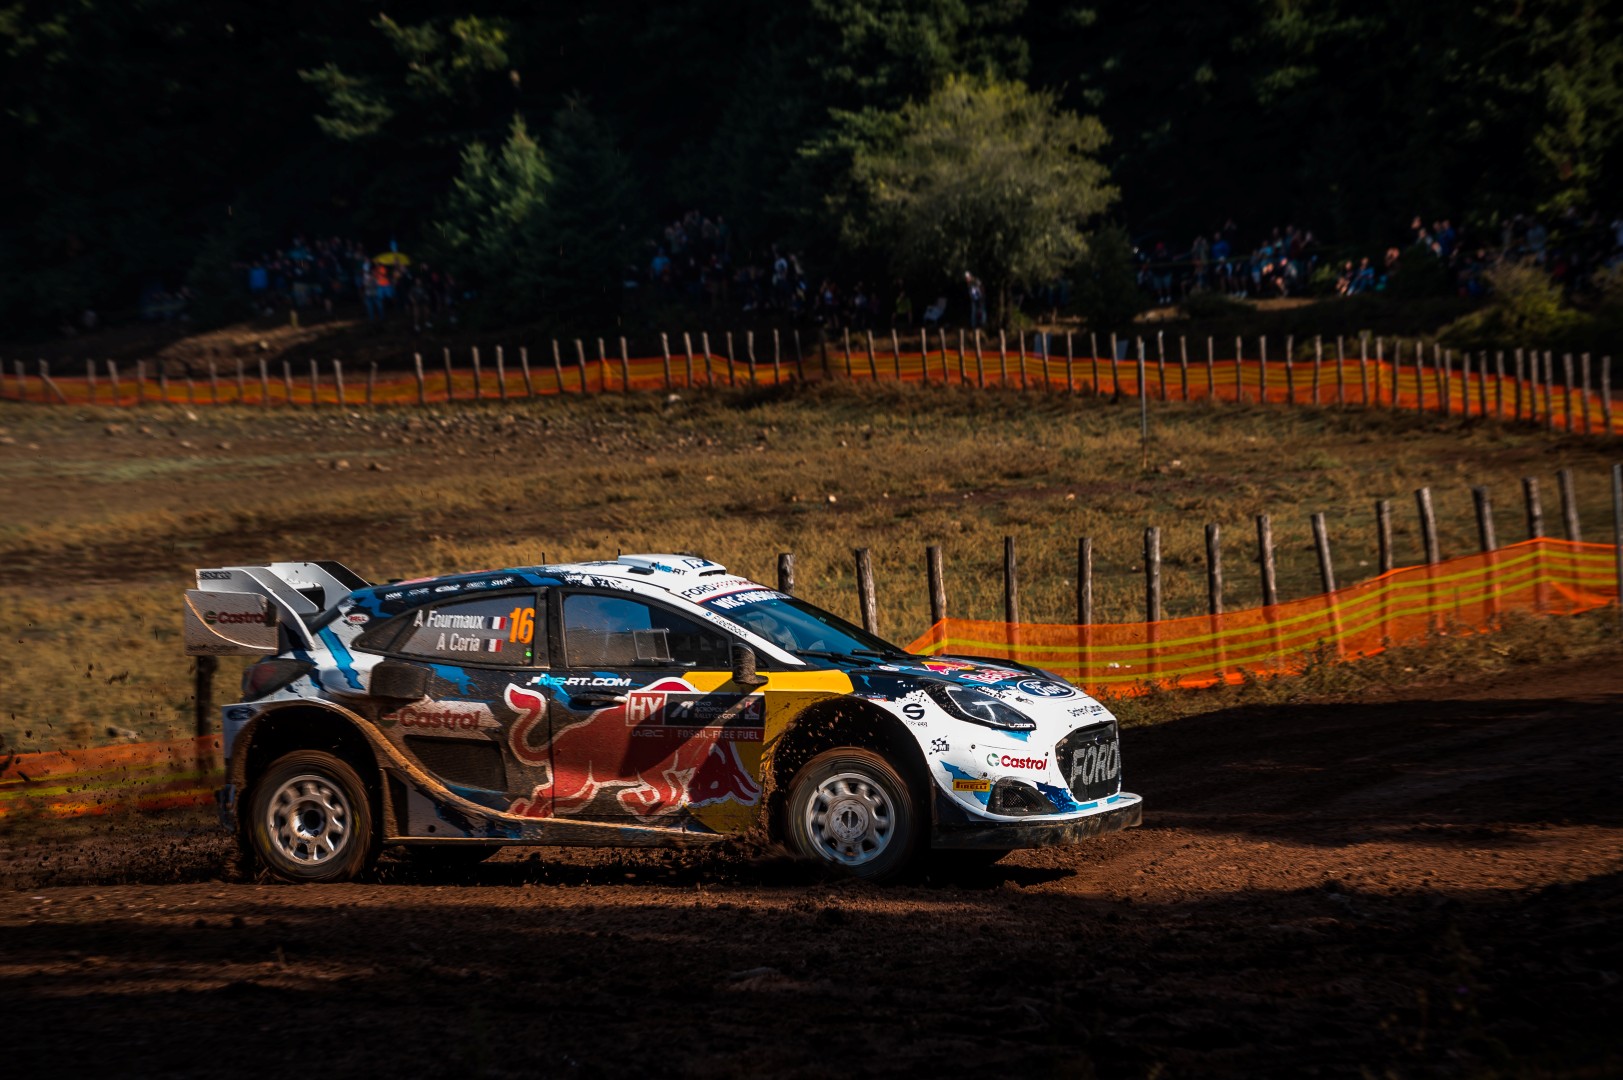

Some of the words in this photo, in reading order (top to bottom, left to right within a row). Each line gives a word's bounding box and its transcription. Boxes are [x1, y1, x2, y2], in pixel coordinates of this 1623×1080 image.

[681, 584, 717, 599] FORD
[216, 611, 269, 624] Castrol
[413, 610, 424, 628] A
[427, 610, 484, 630] Fourmaux
[509, 607, 536, 644] 16
[436, 633, 446, 651] A
[449, 633, 481, 652] Coria
[630, 696, 664, 721] HY
[400, 707, 482, 731] Castrol
[632, 729, 665, 738] WRC
[677, 730, 735, 739] FOSSIL-FREE
[737, 731, 760, 740] FUEL
[1001, 754, 1048, 771] Castrol
[1070, 741, 1120, 788] FORD
[955, 781, 987, 790] PIRELLI
